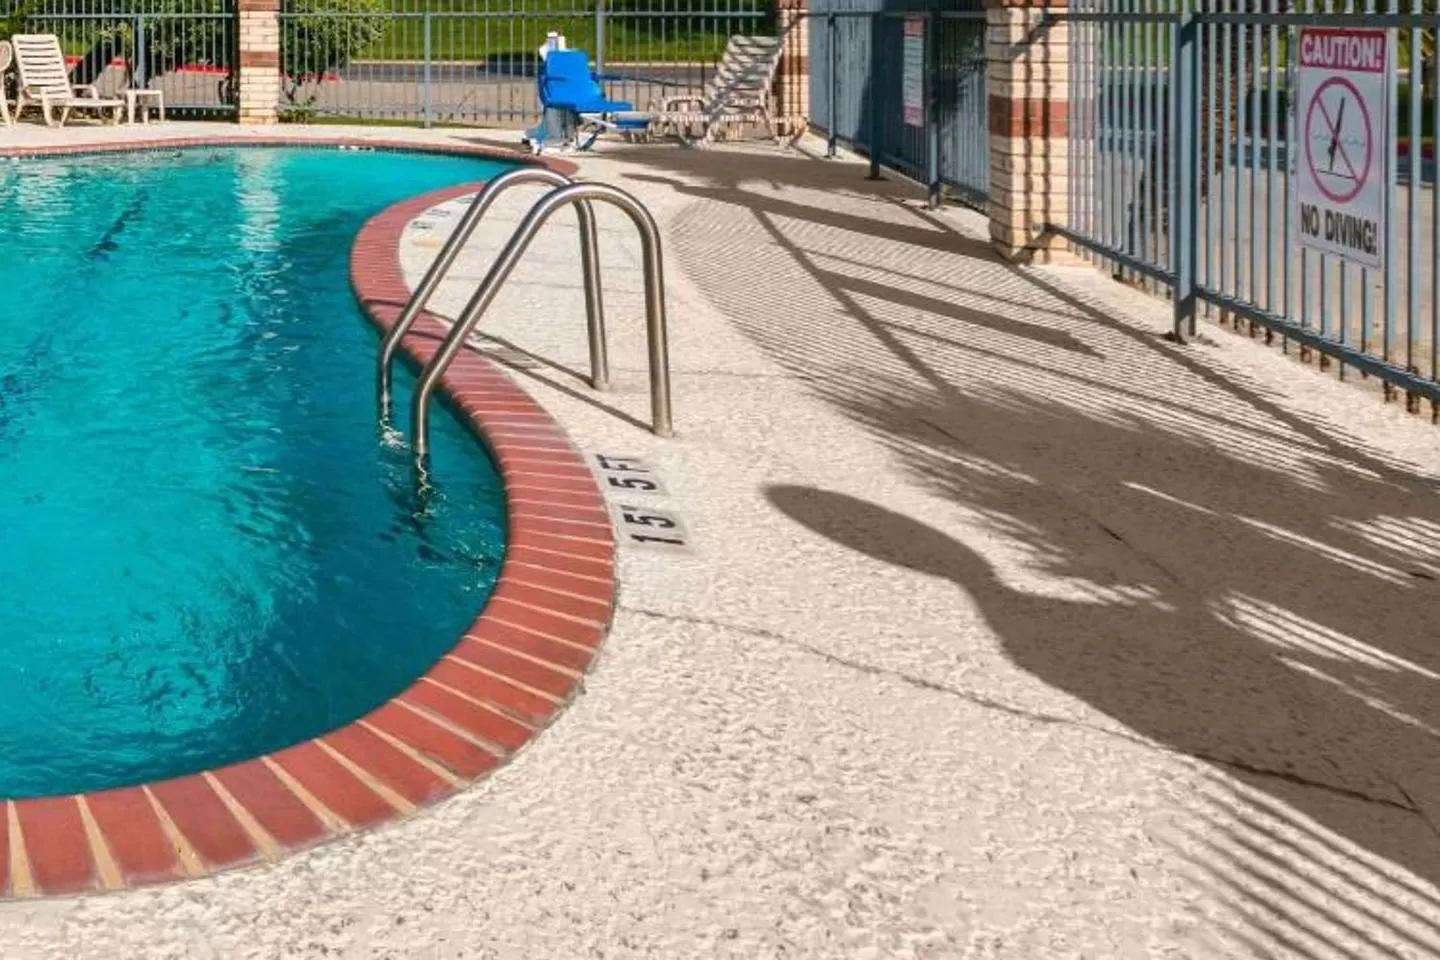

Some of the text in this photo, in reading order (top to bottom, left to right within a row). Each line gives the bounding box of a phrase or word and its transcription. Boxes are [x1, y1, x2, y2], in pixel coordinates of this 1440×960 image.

[1301, 33, 1383, 69] CAUTION!
[1301, 203, 1378, 256] NO DIVING!
[608, 477, 658, 491] 5
